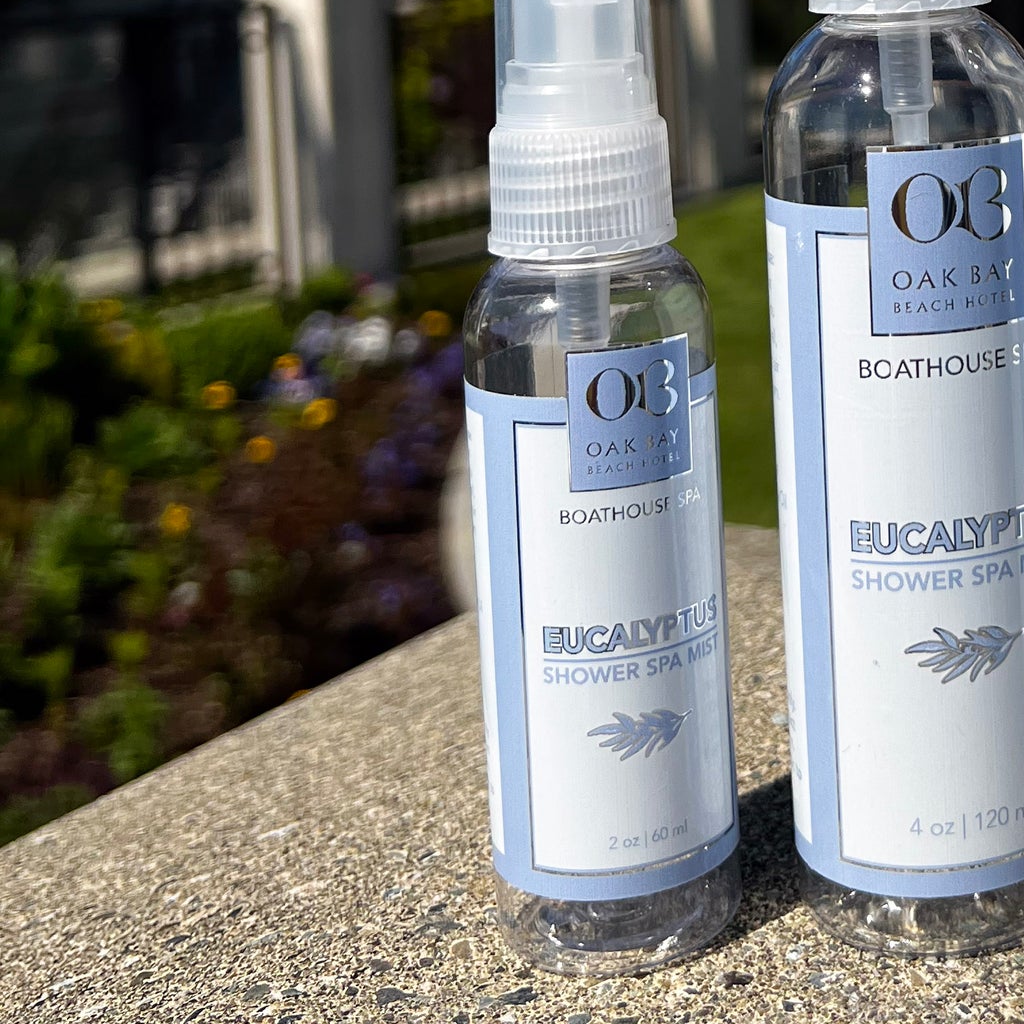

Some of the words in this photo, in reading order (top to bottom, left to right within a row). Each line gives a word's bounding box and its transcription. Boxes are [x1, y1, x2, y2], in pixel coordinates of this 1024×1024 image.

[892, 267, 956, 291] OAK
[970, 258, 1014, 285] BAY
[893, 299, 955, 314] BEACH
[966, 289, 1016, 309] HOTEL
[859, 347, 1007, 380] BOATHOUSE
[586, 437, 637, 457] OAK
[646, 428, 679, 451] BAY
[587, 461, 634, 475] BEACH
[642, 451, 680, 468] HOTEL
[559, 496, 671, 526] BOATHOUSE
[677, 486, 701, 509] SPA
[851, 568, 964, 593] SHOWER
[971, 562, 1014, 587] SPA
[543, 593, 717, 655] EUCALYPTUS
[543, 661, 640, 685] SHOWER
[646, 656, 682, 677] SPA
[688, 631, 719, 664] MIST
[608, 835, 618, 851] 2
[623, 836, 640, 848] oz
[651, 824, 669, 843] 60
[672, 818, 689, 837] ml
[909, 817, 923, 836] 4
[930, 821, 955, 836] oz
[975, 806, 1009, 831] 120
